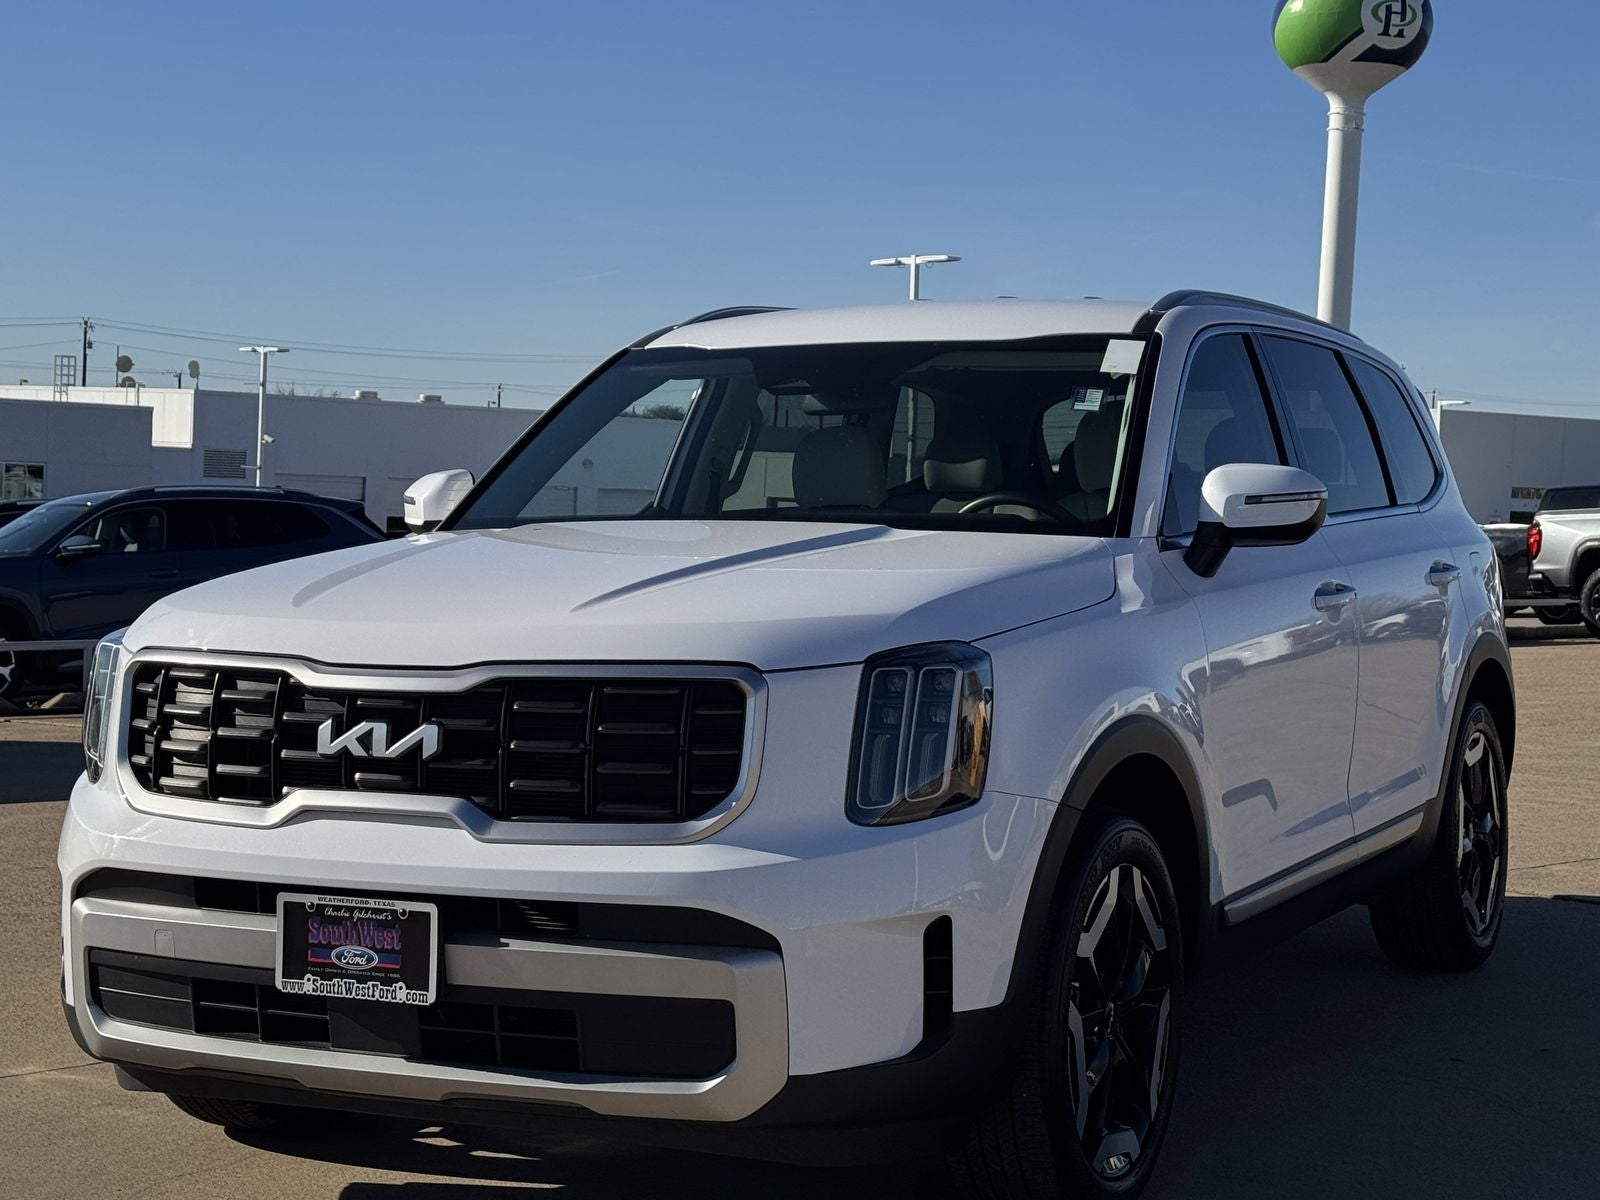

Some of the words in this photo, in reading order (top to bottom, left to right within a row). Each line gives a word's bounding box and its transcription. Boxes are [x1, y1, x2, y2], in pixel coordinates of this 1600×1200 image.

[317, 716, 438, 760] KIA
[324, 906, 350, 917] Charlie
[373, 900, 396, 908] TEXAS
[341, 949, 368, 965] Ford
[281, 978, 429, 1004] www.SouthWestFord.com
